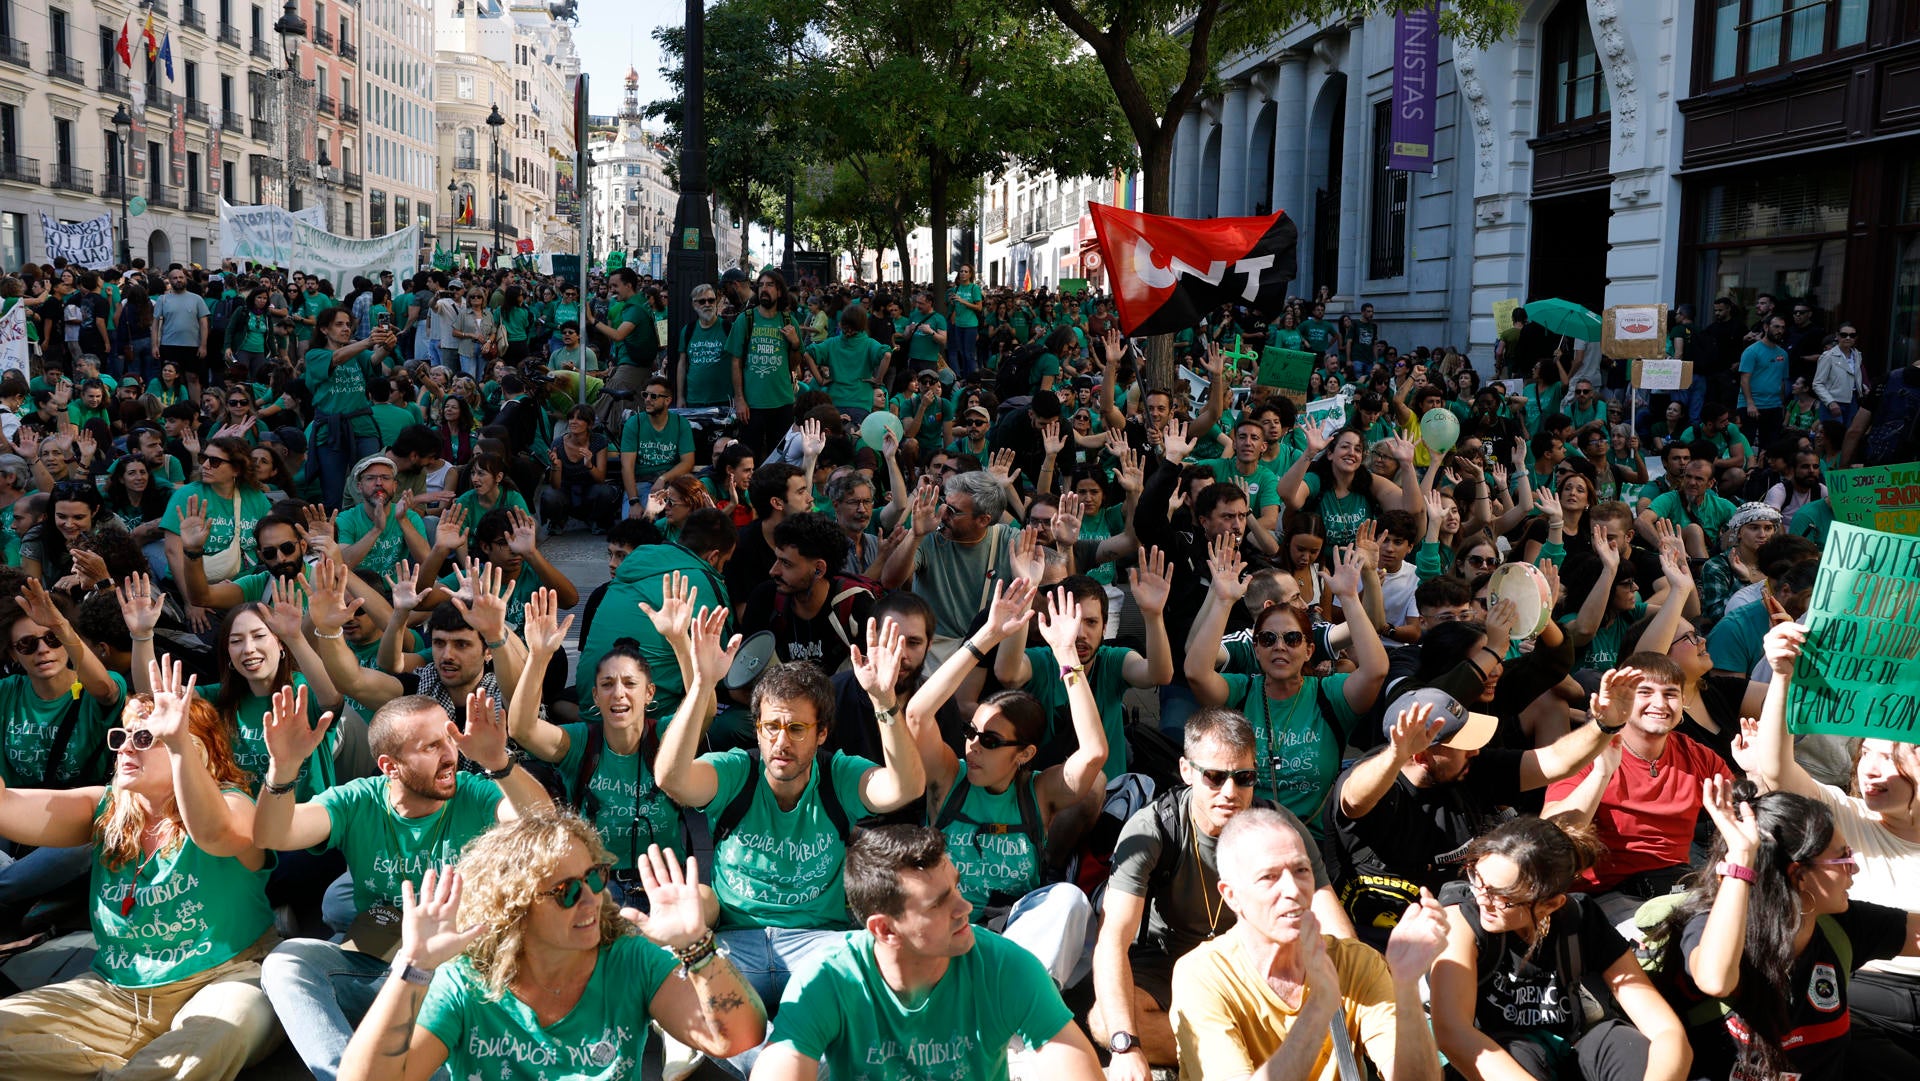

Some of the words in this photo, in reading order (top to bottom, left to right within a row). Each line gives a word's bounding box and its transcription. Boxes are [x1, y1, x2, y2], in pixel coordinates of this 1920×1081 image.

[1134, 236, 1275, 302] CNT
[1830, 474, 1848, 494] NO
[1813, 568, 1840, 612] DE
[1877, 661, 1909, 686] DE
[1260, 757, 1313, 771] TD@S
[736, 829, 785, 858] ESCUELA
[956, 861, 977, 876] DE
